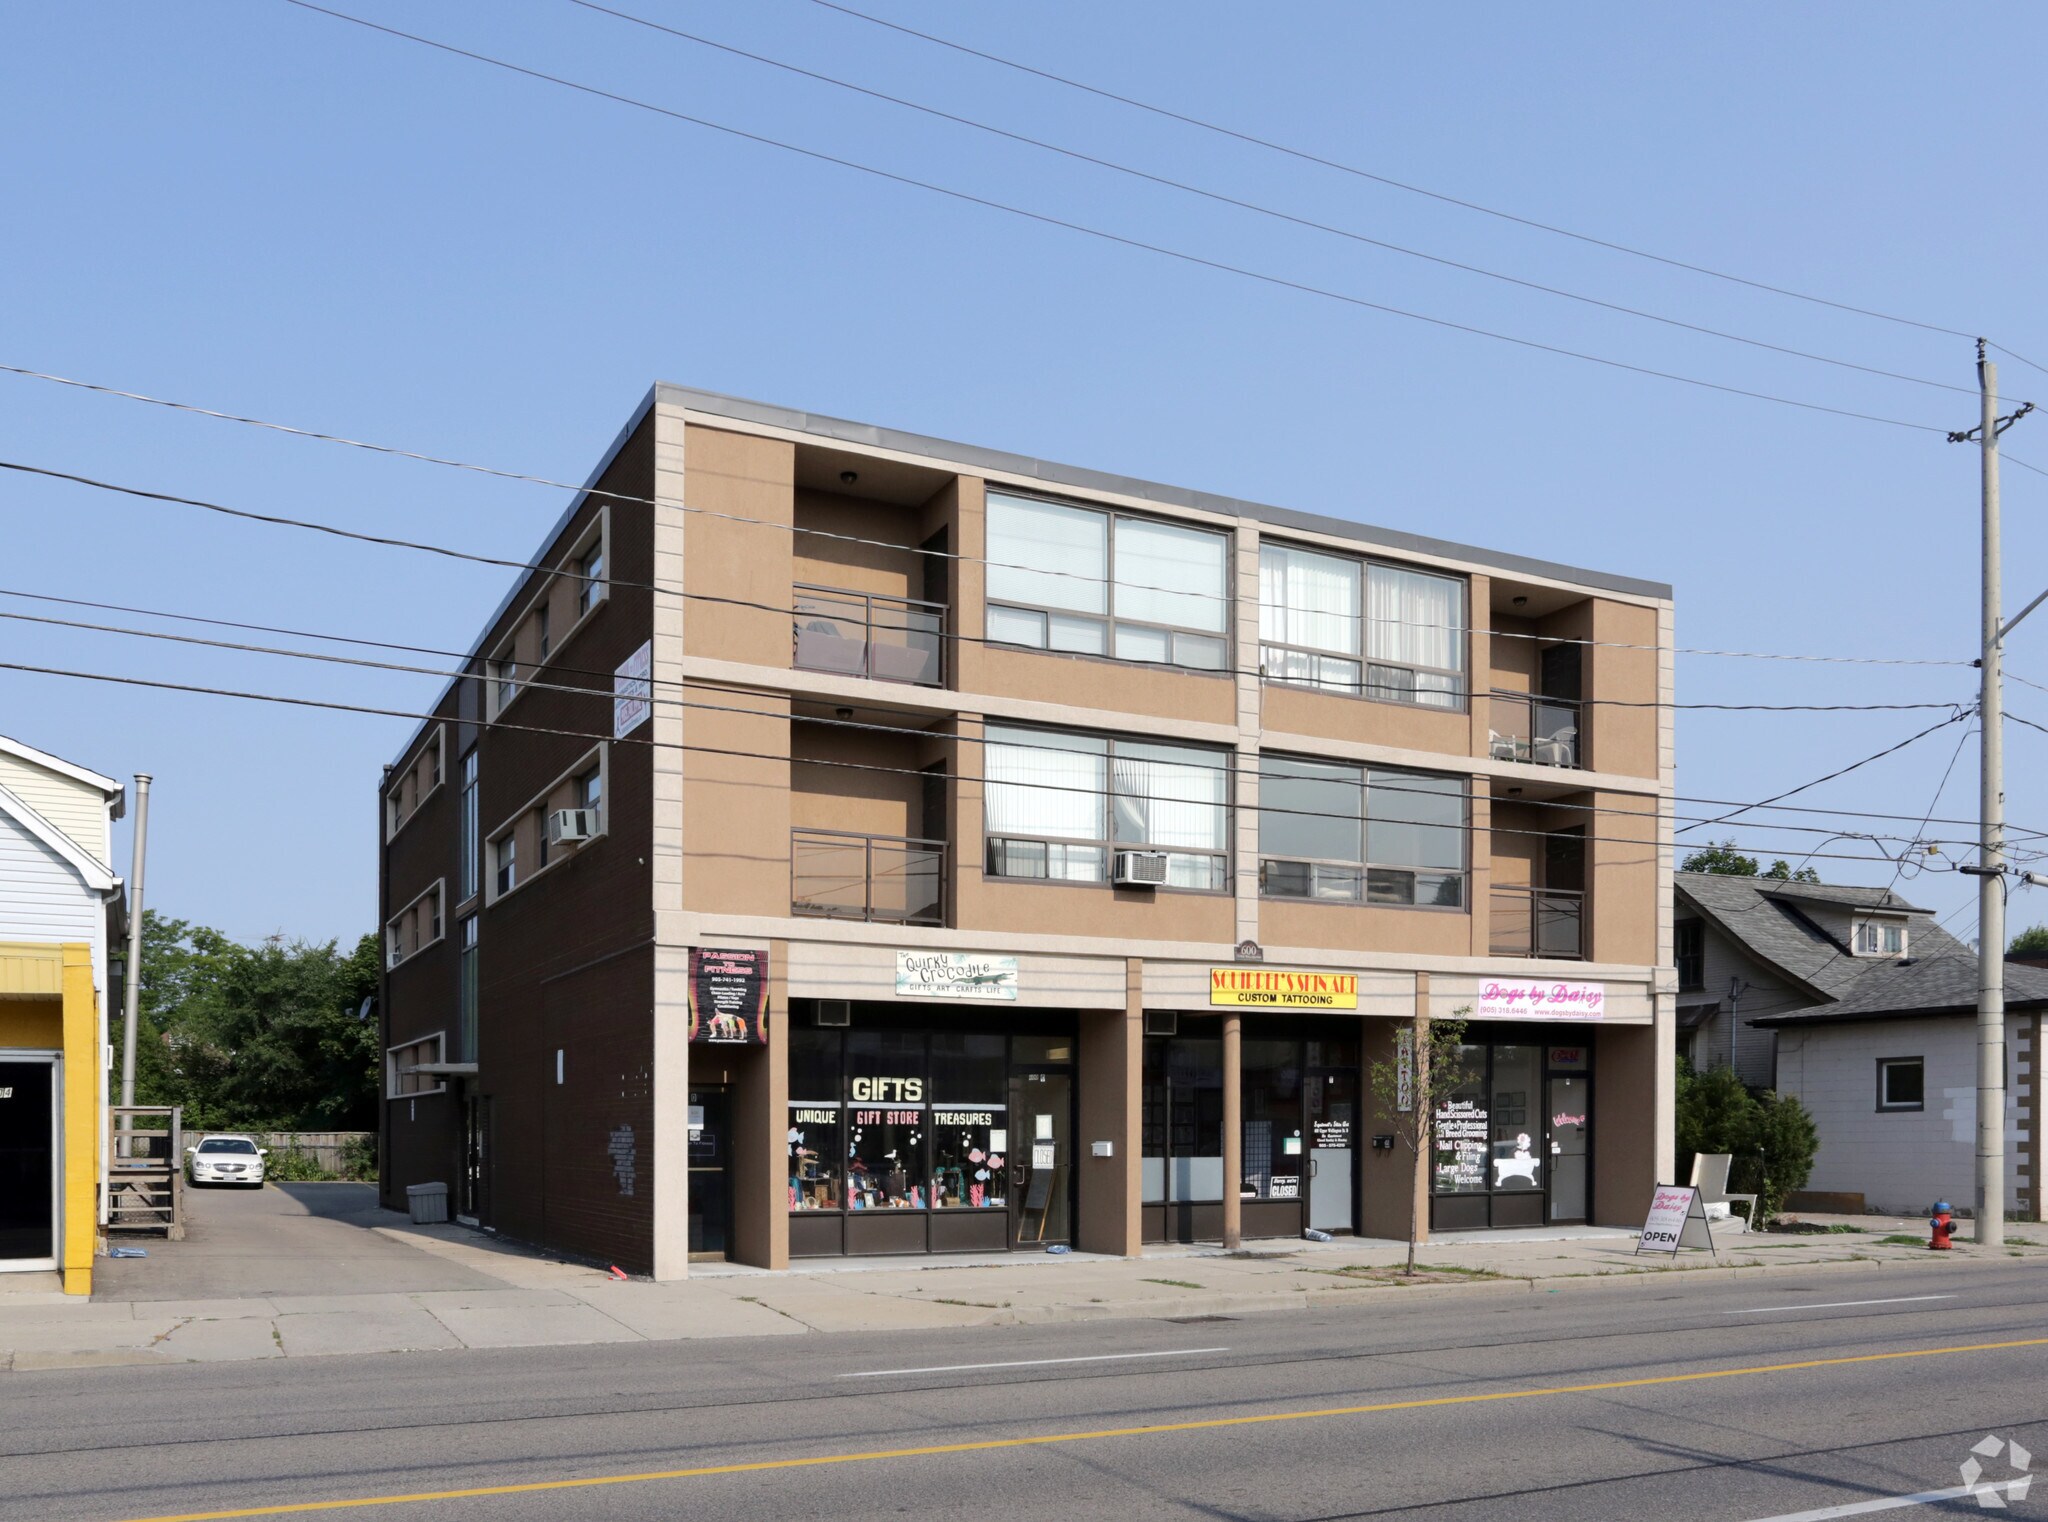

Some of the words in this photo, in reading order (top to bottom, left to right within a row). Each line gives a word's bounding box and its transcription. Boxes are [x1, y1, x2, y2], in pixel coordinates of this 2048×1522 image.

[1241, 945, 1257, 955] 600
[703, 952, 755, 961] PASSION
[704, 966, 753, 975] FITNESS
[1330, 975, 1355, 993] ART
[1238, 993, 1277, 1003] CUSTOM
[1282, 994, 1333, 1004] TATTOOING
[1481, 983, 1526, 1005] Dogs
[1528, 986, 1545, 1006] by
[1547, 984, 1602, 1008] Daisy
[1480, 1006, 1497, 1014] (905)
[1534, 1008, 1601, 1017] www.dogsbydaisy.com
[852, 1077, 923, 1101] GIFTS
[1447, 1101, 1473, 1110] Beautiful
[796, 1110, 836, 1124] UNIQUE
[857, 1111, 881, 1125] GIFT
[887, 1111, 919, 1125] STORE
[934, 1112, 992, 1125] TREASURES
[1450, 1109, 1475, 1119] Scissored
[1475, 1109, 1488, 1119] Cuts
[1457, 1121, 1488, 1131] Professional
[1445, 1130, 1462, 1138] Breed
[1462, 1130, 1488, 1140] Grooming
[1439, 1141, 1453, 1150] Nail
[1454, 1141, 1483, 1151] Clipping
[1462, 1152, 1481, 1163] Filing
[1439, 1163, 1459, 1174] Large
[1461, 1163, 1479, 1174] Dogs
[1454, 1174, 1483, 1184] Welcome
[1272, 1185, 1297, 1197] CLOSED
[1656, 1192, 1679, 1202] Dogs
[1680, 1194, 1690, 1203] by
[1653, 1201, 1682, 1211] Daisy
[1644, 1231, 1677, 1243] OPEN
